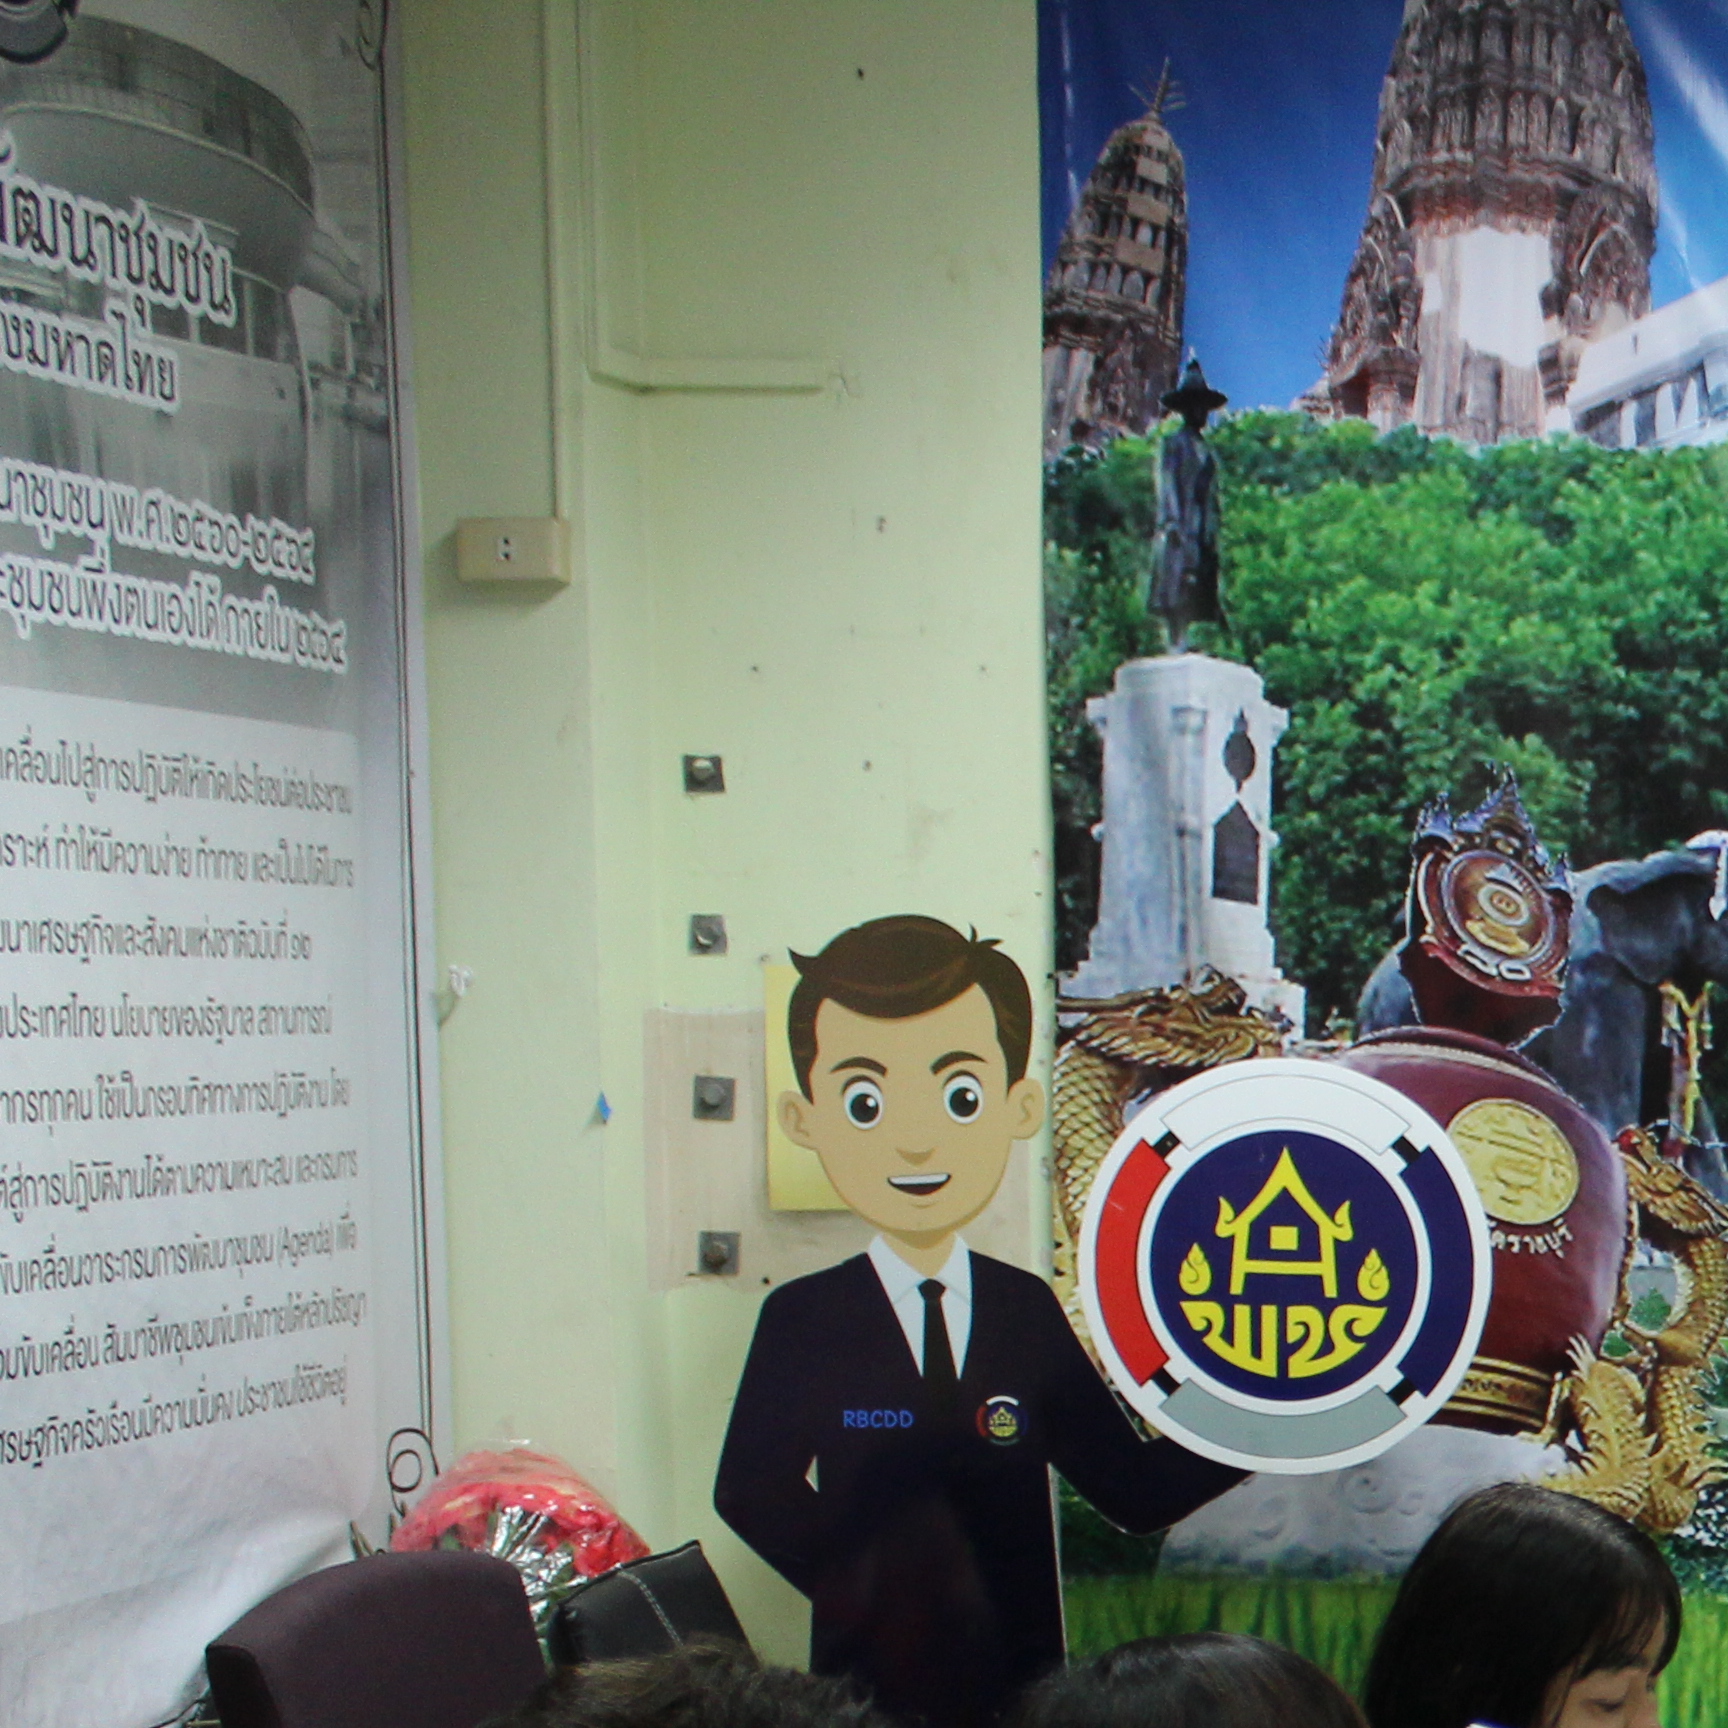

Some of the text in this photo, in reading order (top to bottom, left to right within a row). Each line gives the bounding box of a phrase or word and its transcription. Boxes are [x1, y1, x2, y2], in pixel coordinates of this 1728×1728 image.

[0, 143, 232, 327] ัฒนาชุมชน
[842, 1409, 914, 1429] RBCDD
